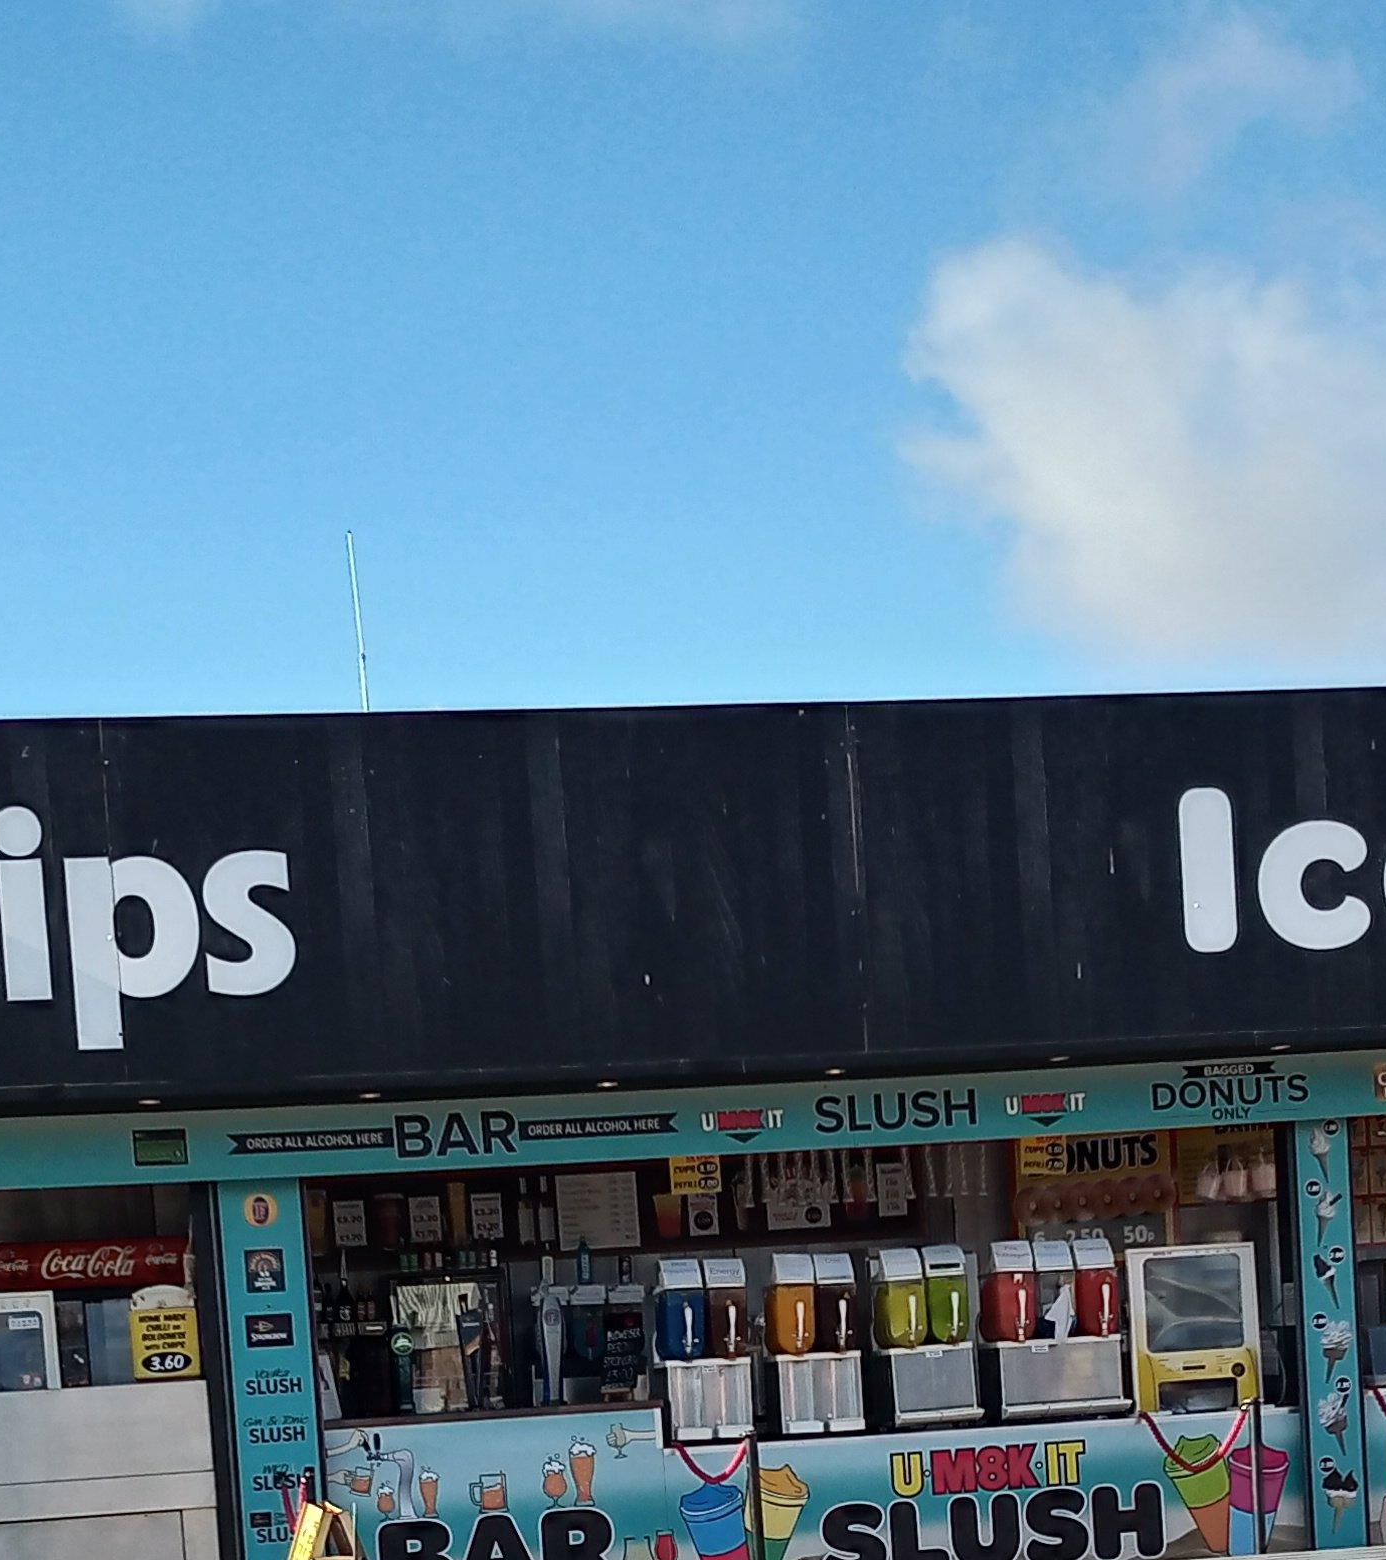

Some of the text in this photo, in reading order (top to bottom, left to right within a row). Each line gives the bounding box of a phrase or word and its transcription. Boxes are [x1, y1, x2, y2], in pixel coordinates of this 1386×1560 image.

[1203, 1064, 1254, 1076] BAGGED
[1151, 1073, 1310, 1111] DONUTS
[815, 1087, 979, 1136] SLUSH
[1211, 1107, 1251, 1120] ONLY
[394, 1110, 518, 1158] BAR
[528, 1118, 660, 1136] ORDER ALL ALCOHOL HERE
[246, 1132, 383, 1150] ORDER ALL ALCOHOL HERE
[1066, 1133, 1158, 1176] NUTS
[40, 1245, 137, 1280] Coca-Cola
[150, 1356, 186, 1371] 3.60
[245, 1377, 302, 1395] SLUSH
[248, 1426, 305, 1444] SLUSH
